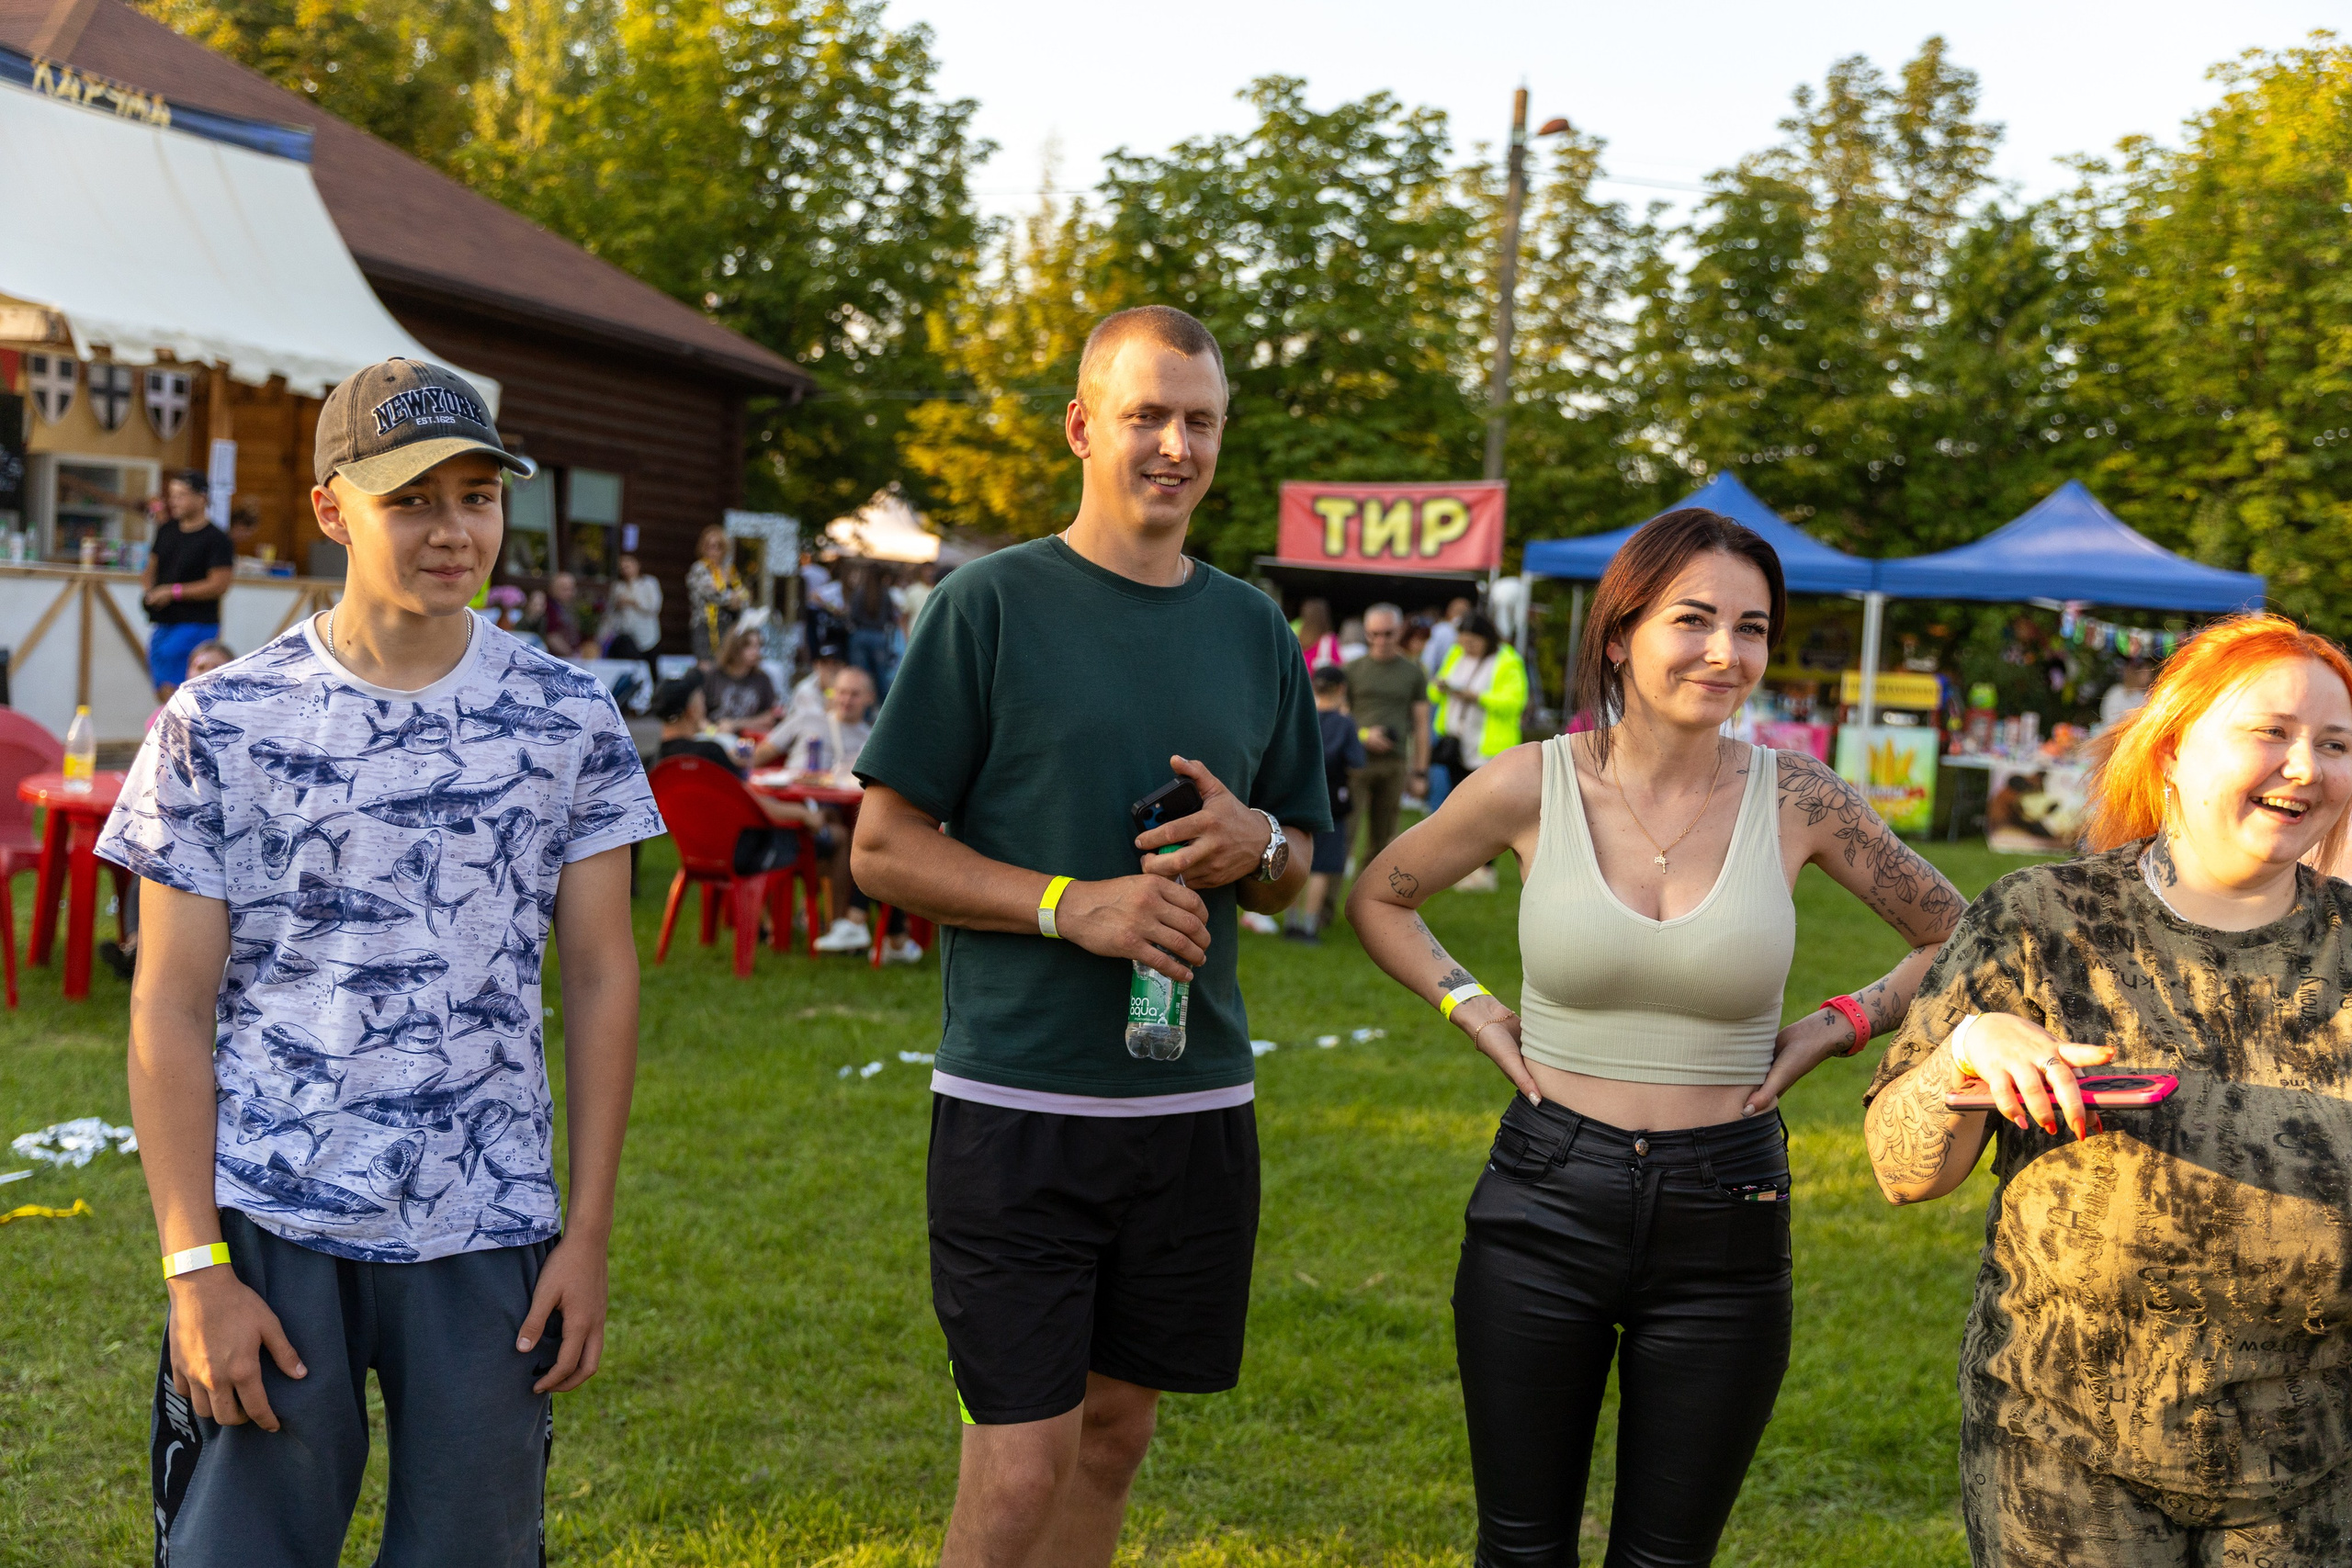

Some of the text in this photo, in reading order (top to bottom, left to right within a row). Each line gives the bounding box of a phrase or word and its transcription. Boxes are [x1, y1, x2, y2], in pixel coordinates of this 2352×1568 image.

[1314, 496, 1470, 558] ТИР
[1130, 996, 1149, 1007] bon
[1130, 1006, 1158, 1018] aqua
[164, 1372, 197, 1443] NIKE
